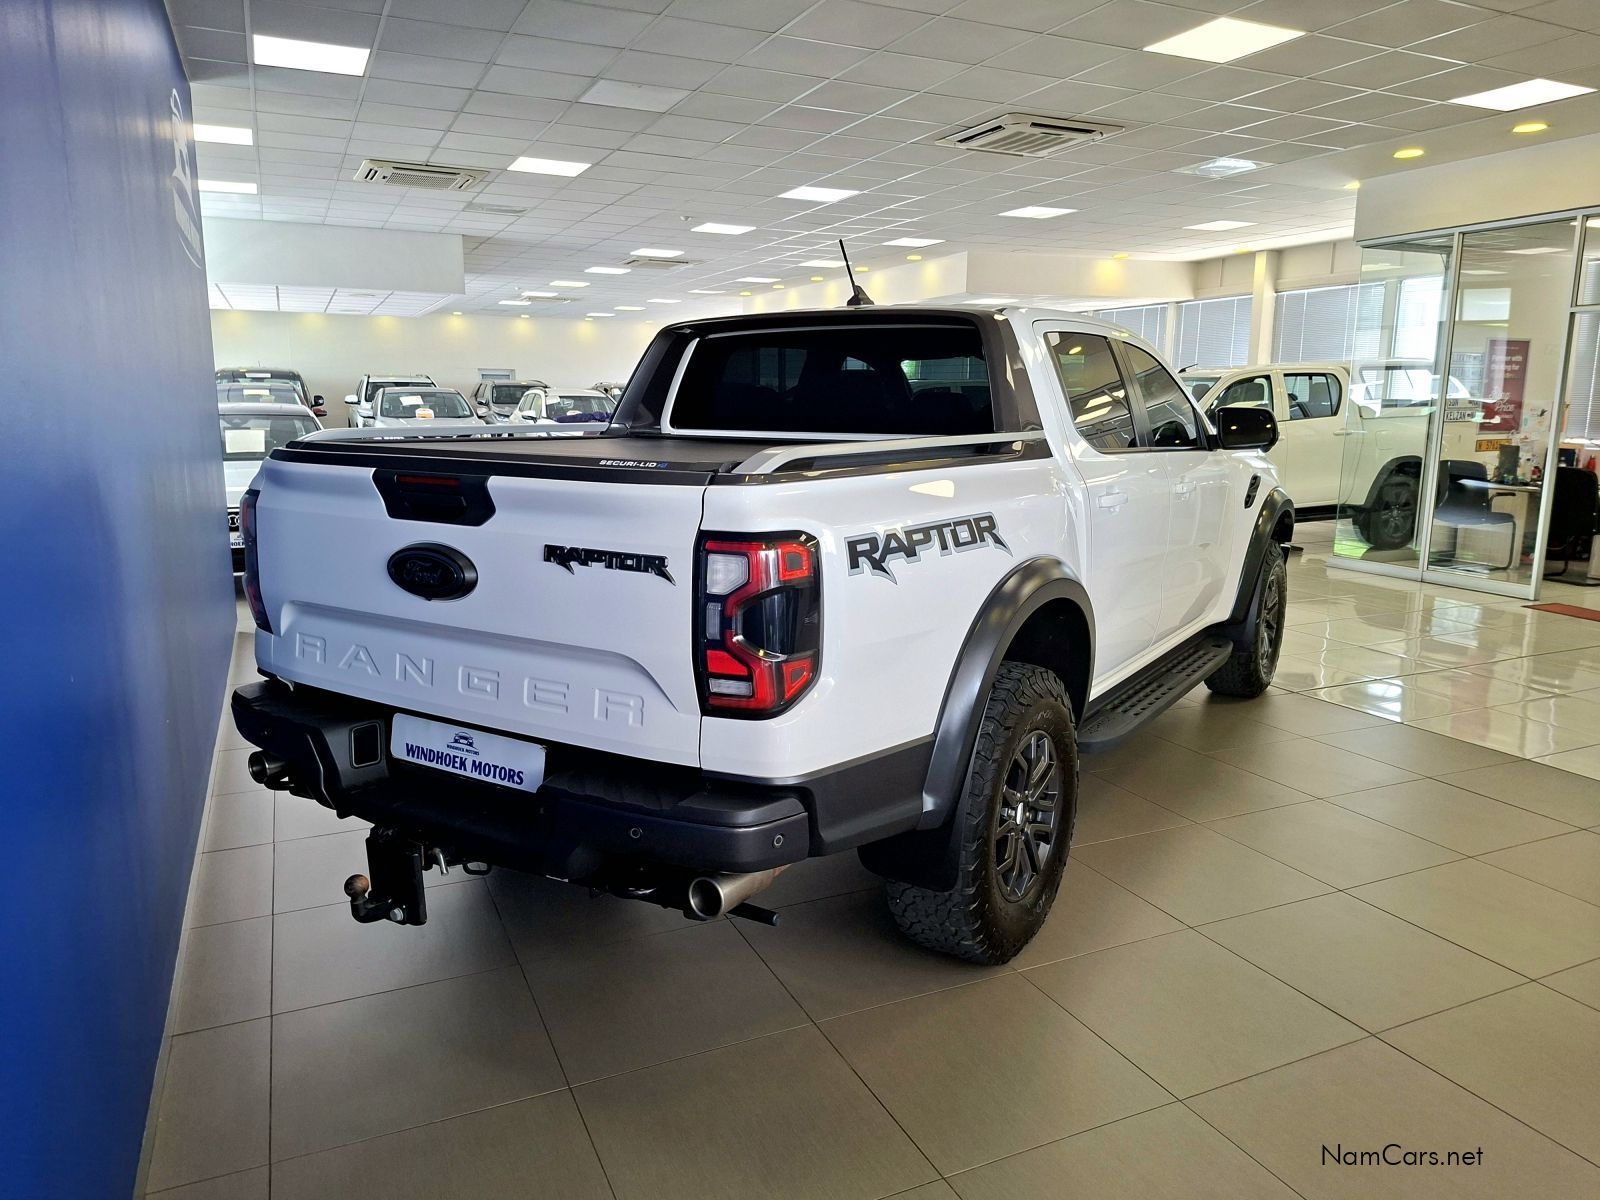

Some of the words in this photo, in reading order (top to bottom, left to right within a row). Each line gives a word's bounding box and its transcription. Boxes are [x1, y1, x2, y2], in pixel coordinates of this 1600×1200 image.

[599, 459, 657, 468] SECURI-LID
[543, 544, 676, 586] RAPTOR
[844, 511, 1013, 585] RAPTOR
[295, 632, 645, 728] RANGER
[405, 742, 468, 772] WINDHOEK
[470, 759, 524, 786] MOTORS
